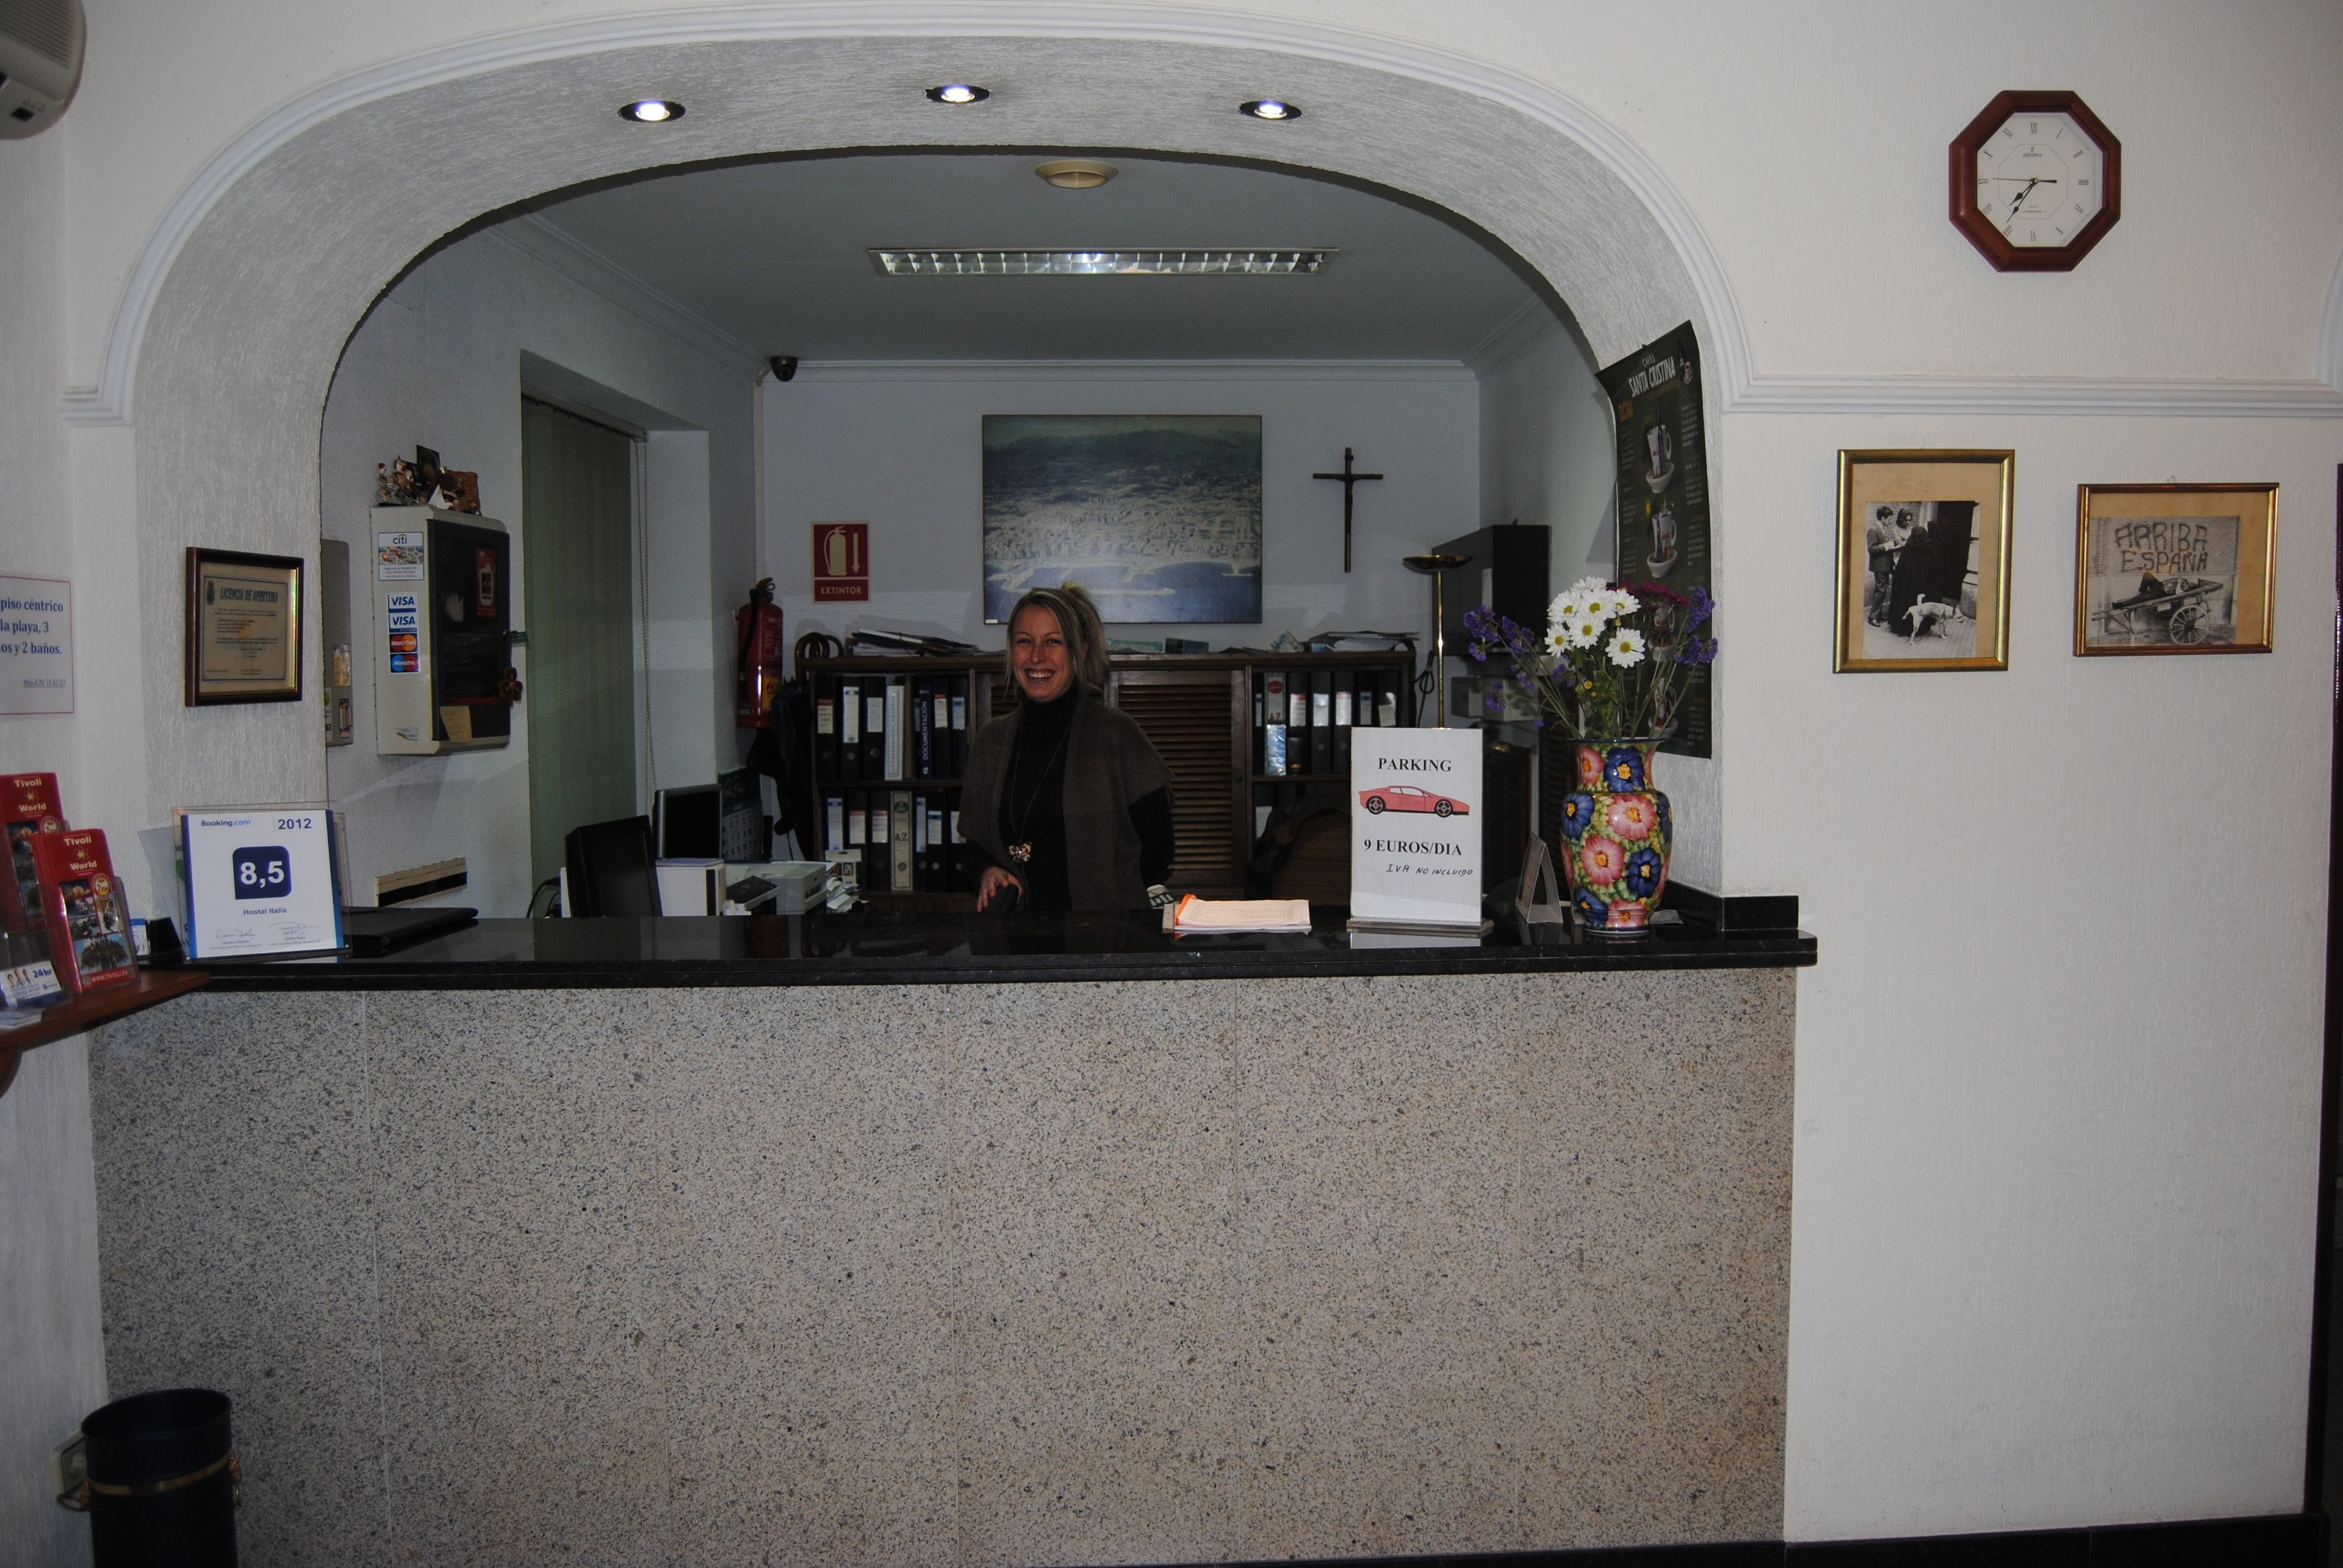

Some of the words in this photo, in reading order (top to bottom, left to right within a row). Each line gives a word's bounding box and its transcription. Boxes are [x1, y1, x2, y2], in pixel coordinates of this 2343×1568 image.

[1629, 371, 1649, 398] SANTA
[1649, 356, 1675, 388] CRISTINA
[2115, 522, 2208, 553] ARRIBA
[220, 588, 243, 601] LICENCIA
[245, 589, 252, 602] DE
[253, 590, 278, 603] APERTURA
[820, 586, 862, 594] EXTINTOR
[1, 597, 22, 611] piso
[24, 599, 63, 612] céntrico
[391, 596, 415, 606] VISA
[0, 619, 10, 631] la
[13, 619, 41, 635] playa,
[43, 621, 49, 633] 3
[392, 616, 416, 625] VISA
[15, 644, 20, 656] y
[23, 642, 27, 653] 2
[31, 642, 62, 654] baños.
[1378, 758, 1452, 772] PARKING
[15, 779, 41, 788] Tivoli
[19, 803, 46, 812] World
[278, 818, 312, 830] 2012
[64, 836, 92, 846] Tivoli
[1364, 839, 1371, 851] 9
[1377, 840, 1462, 855] EUROS/DIA
[70, 860, 98, 871] World
[1386, 864, 1409, 872] IVA
[241, 861, 284, 888] 8,5
